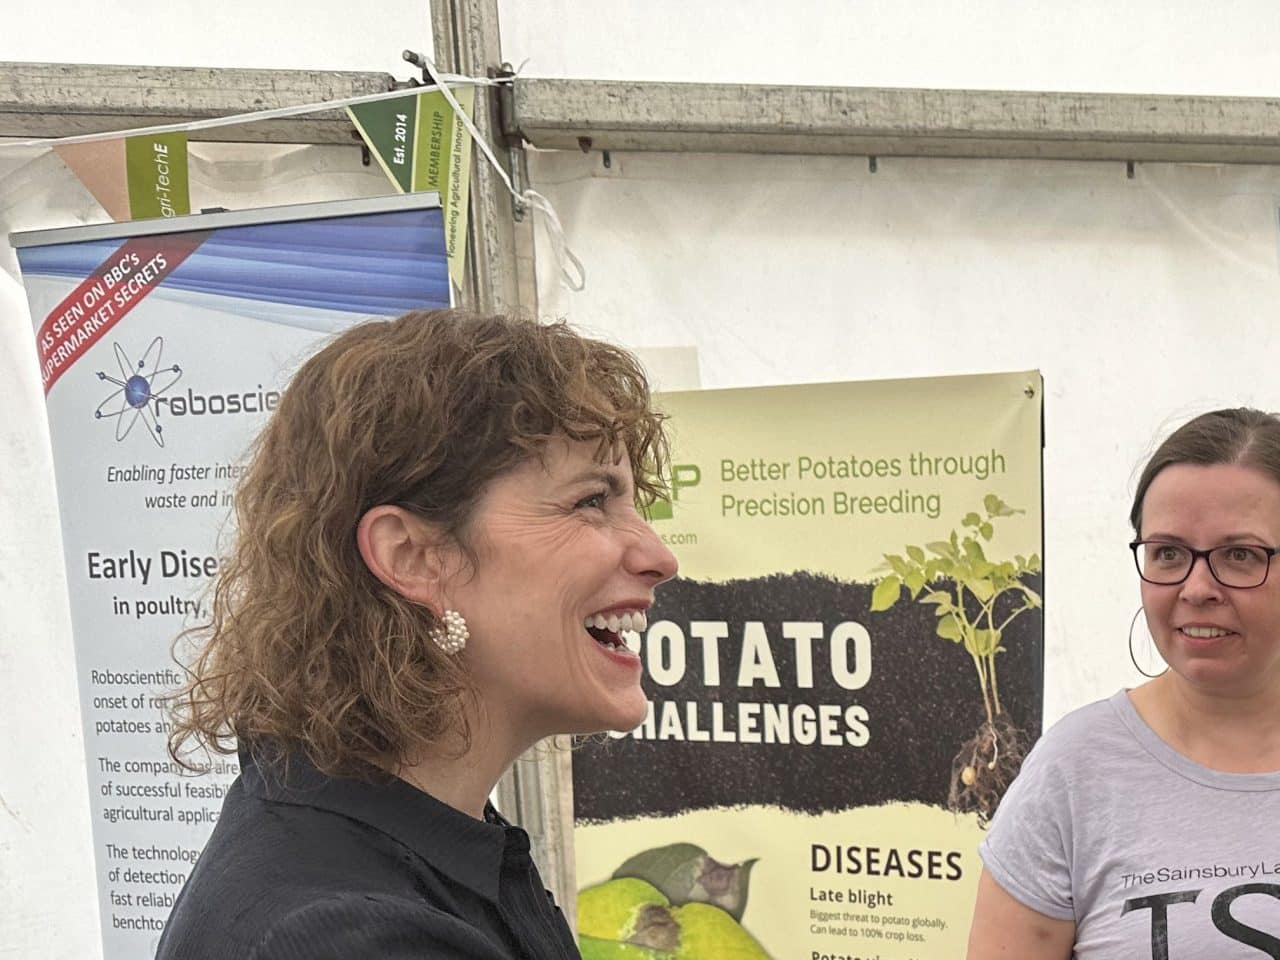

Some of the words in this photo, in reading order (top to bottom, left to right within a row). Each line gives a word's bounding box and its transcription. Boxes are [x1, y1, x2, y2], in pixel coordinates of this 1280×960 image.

[395, 113, 408, 142] 2014
[393, 142, 405, 165] Est.
[428, 111, 445, 187] MEMBERSHIP
[450, 156, 462, 207] Agricultural
[113, 253, 168, 308] SECRETS
[41, 331, 54, 355] AS
[52, 302, 85, 339] SEEN
[83, 282, 105, 308] ON
[103, 252, 141, 290] BBC's
[107, 464, 165, 484] Enabling
[169, 463, 211, 484] faster
[720, 459, 790, 482] Better
[799, 455, 901, 480] Potatoes
[909, 449, 1006, 480] through
[144, 494, 186, 508] waste
[190, 491, 218, 508] and
[721, 492, 825, 517] Precision
[833, 490, 942, 520] Breeding
[88, 549, 152, 585] Early
[113, 596, 130, 615] in
[136, 595, 207, 619] poultry,
[638, 620, 872, 690] OTATO
[91, 669, 182, 685] Roboscientific
[93, 694, 127, 710] onset
[131, 693, 145, 709] of
[96, 719, 151, 736] potatoes
[98, 757, 121, 773] The
[101, 781, 113, 797] of
[116, 782, 181, 798] successful
[103, 805, 174, 823] agricultural
[106, 844, 128, 860] The
[811, 844, 962, 881] DISEASES
[109, 868, 120, 883] of
[124, 868, 187, 885] detection
[111, 891, 133, 906] fast
[810, 887, 843, 903] Late
[848, 888, 893, 909] blight
[843, 910, 869, 923] threat
[870, 913, 880, 924] to
[882, 915, 910, 928] potato
[912, 917, 949, 931] globally.
[810, 924, 827, 935] Can
[829, 925, 847, 937] lead
[848, 927, 858, 937] to
[860, 928, 883, 939] 100%
[885, 930, 905, 943] crop
